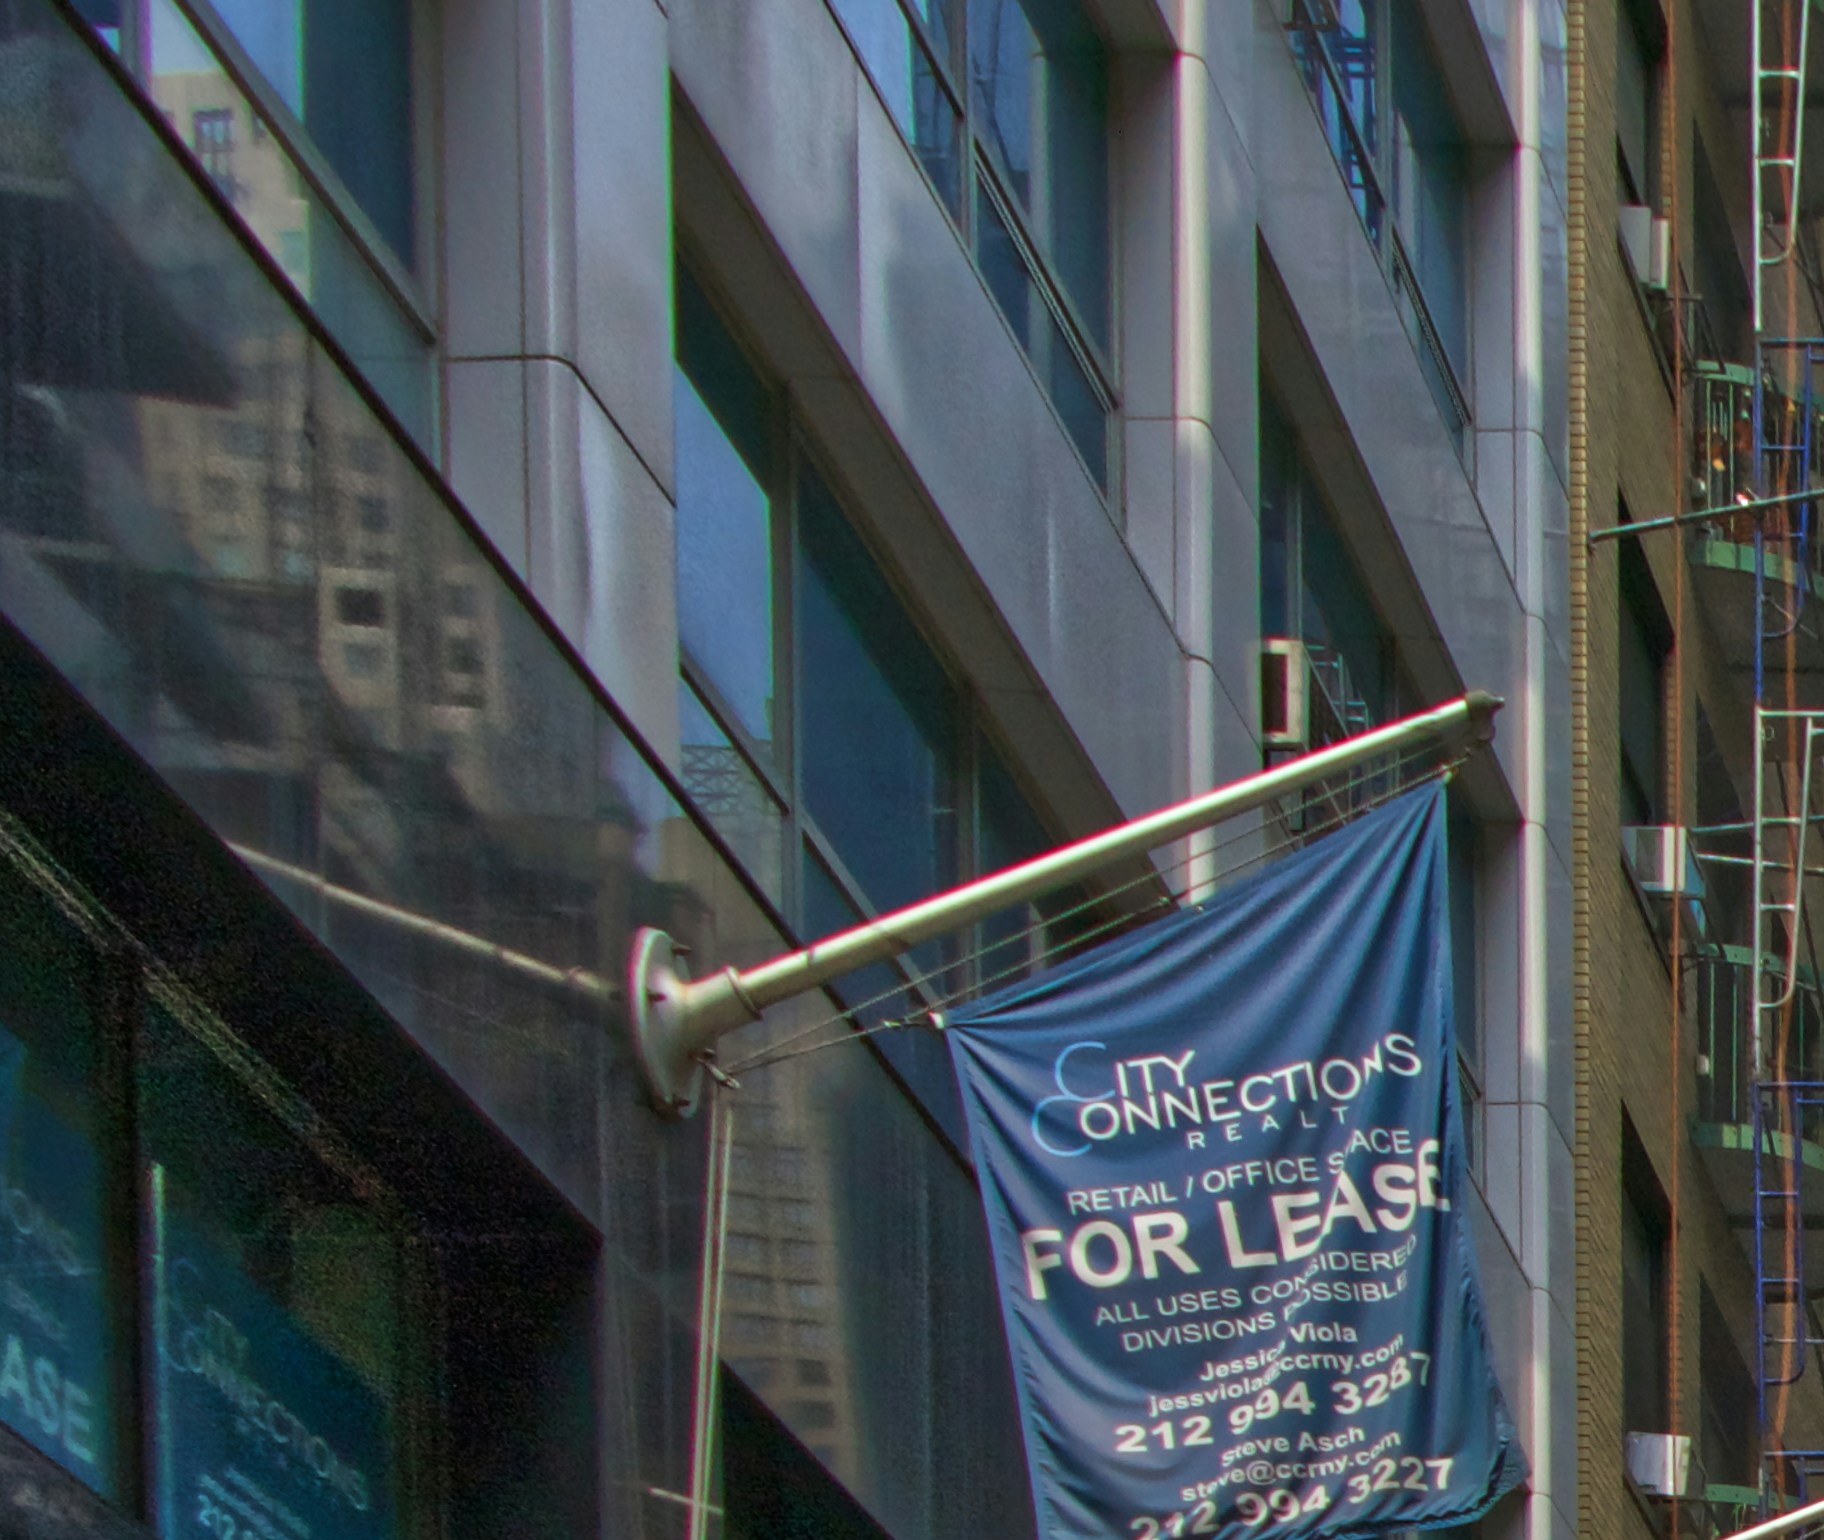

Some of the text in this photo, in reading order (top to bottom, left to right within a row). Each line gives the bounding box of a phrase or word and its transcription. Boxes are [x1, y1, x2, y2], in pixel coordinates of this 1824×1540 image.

[1031, 1034, 1422, 1158] CONNECTIONS
[1055, 1041, 1196, 1101] CITY
[1187, 1105, 1349, 1151] REALT
[1067, 1129, 1413, 1216] RETAIL / OFFICE SACE
[1021, 1139, 1451, 1301] FOR LEASE
[1095, 1234, 1418, 1327] ALL USES CONSIDERED
[1122, 1270, 1409, 1353] DIVISIONS POSSIBLE
[1289, 1322, 1358, 1344] Viola
[1113, 1350, 1432, 1453] 212 994 3287
[1297, 1426, 1366, 1453] Asch
[1180, 1431, 1402, 1503] steve@ccrny.com
[1235, 1484, 1332, 1527] 994
[1347, 1455, 1455, 1505] 3227
